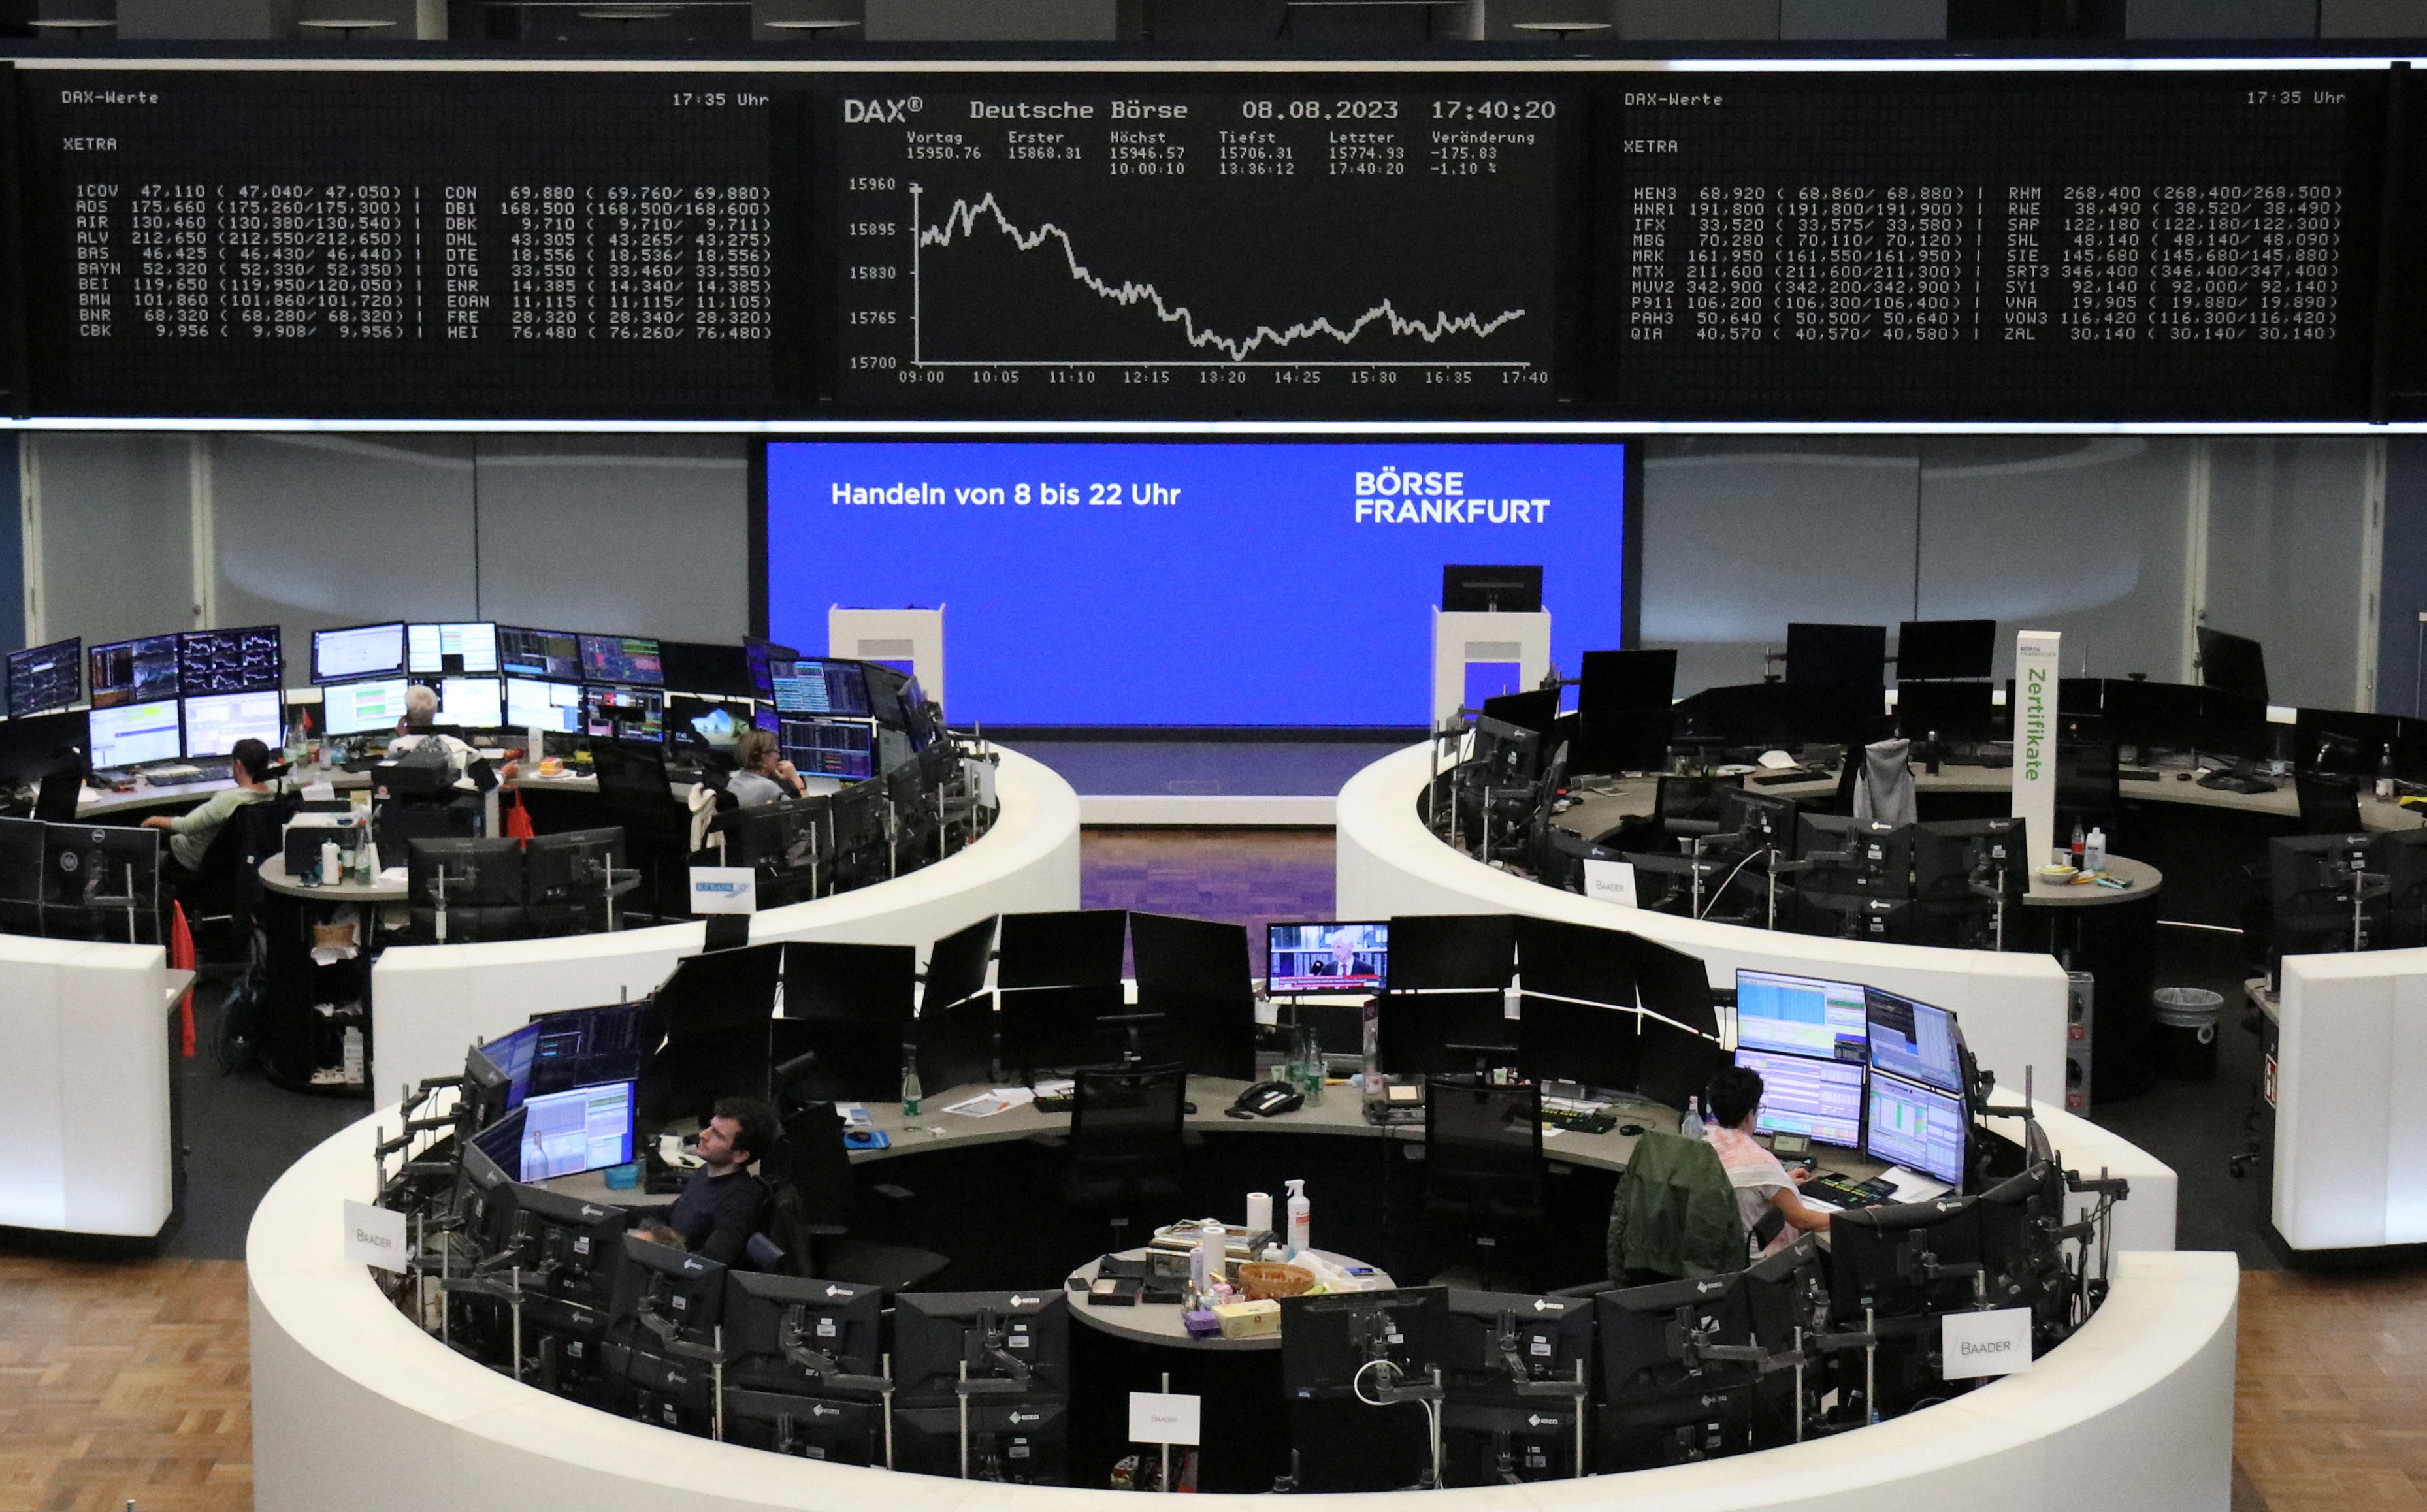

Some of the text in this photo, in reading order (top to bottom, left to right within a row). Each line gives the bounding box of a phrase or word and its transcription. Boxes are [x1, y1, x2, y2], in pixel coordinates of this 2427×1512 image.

[62, 91, 158, 103] DAX-Werte
[674, 93, 768, 106] 17:35 Uhr
[1625, 93, 1722, 105] DAX-Werte
[2249, 91, 2345, 104] 17:35 Uhr
[971, 100, 1187, 118] Deutsche Börse
[1243, 101, 1555, 120] 08.08.2023 17:40:20
[907, 131, 1165, 144] Vortag Erster Höchst
[1220, 131, 1534, 145] Tiefst Letzter Veränderung
[64, 138, 116, 150] XETRA
[1625, 140, 1677, 152] XETRA
[908, 146, 1184, 159] 15950.76 15868.31 15946.57
[1221, 146, 1496, 159] 15706.31 15774.93 -175.83
[1111, 163, 1184, 174] 10:00:10
[1220, 162, 1496, 174] 13:36:12 17:40:20 -1.10 %
[851, 178, 895, 190] 15960
[78, 184, 204, 197] 1COV 47,110
[446, 186, 574, 199] CON 69,880
[1635, 187, 1765, 199] HEN3 68,920
[2010, 187, 2040, 199] RHM
[2064, 187, 2140, 199] 268,400
[76, 200, 107, 212] ADS
[133, 201, 205, 213] 175,660
[446, 202, 474, 214] DB1
[502, 202, 574, 215] 168,500
[1634, 203, 1674, 215] HNR1
[1691, 203, 1764, 215] 191,800
[2009, 202, 2140, 215] RWE 38,490
[77, 216, 107, 228] AIR
[133, 216, 206, 229] 130,460
[446, 217, 574, 230] DBK 9,710
[1635, 219, 1763, 231] IFX 33,520
[2008, 218, 2039, 231] SAP
[2065, 218, 2139, 231] 122,180
[851, 223, 895, 235] 15895
[78, 231, 206, 244] ALV 212,650
[446, 233, 574, 246] DHL 43,305
[1633, 234, 1763, 246] MBG 70,280
[2008, 234, 2139, 246] SHL 48,140
[78, 247, 206, 259] BAS 46,425
[446, 249, 575, 261] DTE 18,556
[1633, 250, 1663, 261] MRK
[1689, 250, 1763, 262] 161,950
[2008, 249, 2038, 262] SIE
[2064, 249, 2138, 262] 145,680
[78, 263, 207, 275] BAYN 52,320
[447, 264, 575, 277] DTG 33,550
[851, 266, 896, 279] 15830
[1633, 265, 1762, 278] MTX 211,600
[2007, 265, 2138, 277] SRT3 346,400
[79, 278, 108, 290] BEI
[135, 278, 207, 291] 119,650
[447, 280, 575, 292] ENR 14,385
[1633, 281, 1674, 293] MUV2
[1687, 281, 1762, 293] 342,900
[2006, 281, 2137, 293] SY1 92,140
[80, 293, 208, 306] BMW 101,860
[448, 295, 576, 308] EOAN 11,115
[1632, 297, 1761, 309] P911 106,200
[2006, 296, 2136, 308] VNA 19,905
[80, 309, 208, 321] BNR 68,320
[448, 311, 576, 323] FRE 28,320
[851, 312, 896, 324] 15765
[1632, 312, 1761, 324] PAH3 50,640
[2006, 312, 2136, 324] VOW3 116,420
[80, 324, 208, 337] CBK 9,956
[448, 326, 576, 338] HEI 76,480
[1631, 328, 1761, 340] QIA 40,570
[2005, 328, 2135, 340] ZAL 30,140
[851, 357, 896, 368] 15700
[899, 370, 1169, 383] 09:00 10:05 11:10 12:15
[1201, 371, 1548, 383] 13:20 14:25 15:30 16:35 17:40
[1356, 466, 1463, 496] BÖRSE
[831, 482, 1181, 505] Handeln von 8 bis 22 Uhr
[1355, 499, 1550, 523] FRANKFURT
[2025, 668, 2046, 781] Zertifikate
[1596, 880, 1624, 892] BAADER
[356, 1229, 391, 1248] BAADER
[1961, 1341, 2011, 1355] BAADER
